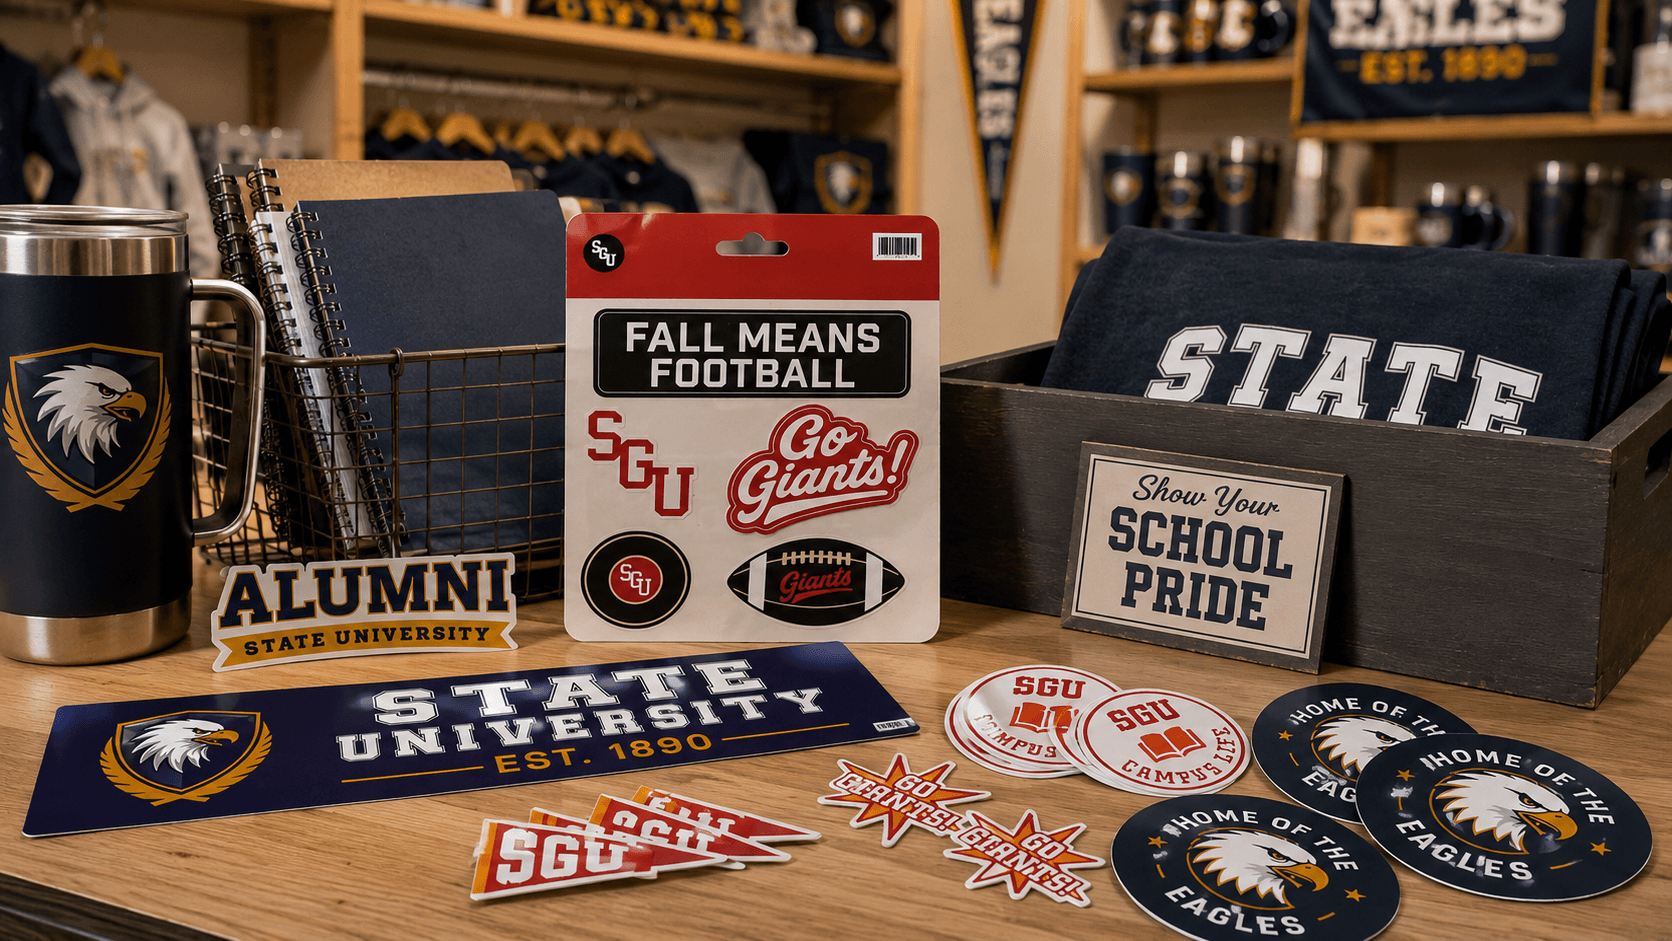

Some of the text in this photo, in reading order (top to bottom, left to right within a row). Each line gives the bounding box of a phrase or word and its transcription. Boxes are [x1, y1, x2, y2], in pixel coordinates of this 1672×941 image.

[1359, 48, 1434, 84] EST.
[591, 239, 617, 267] SGU
[626, 322, 880, 354] FALL MEANS
[650, 358, 856, 389] FOOTBALL
[1144, 323, 1544, 436] STATE
[779, 414, 858, 460] Go
[588, 410, 694, 517] SGU
[737, 439, 909, 523] Giants!
[1132, 474, 1280, 516] Show Your
[1108, 506, 1293, 579] SCHOOL
[218, 559, 509, 630] ALUMNI
[620, 564, 652, 596] SGU
[779, 567, 852, 603] Giants
[1121, 561, 1270, 631] PRIDE
[244, 626, 490, 656] STATE UNIVERSITY
[372, 658, 768, 726] STATE
[1012, 675, 1086, 699] SGU
[335, 687, 823, 762] UNIVERSITY
[1107, 699, 1180, 732] SGU
[1290, 697, 1447, 737] HOME OF TH
[494, 733, 712, 773] EST. 1890
[1121, 759, 1223, 785] CAMPUS
[835, 772, 960, 832] GIANTS!
[894, 774, 938, 799] GO
[1302, 771, 1356, 802] EAG
[1428, 749, 1615, 825] HOME OF THE
[496, 827, 630, 886] SGU
[960, 826, 1083, 897] GIANTS!
[1022, 833, 1066, 859] GO
[1171, 809, 1359, 871] HOME OF THE
[1396, 819, 1533, 880] EAGLES
[1164, 886, 1305, 936] EAGLES
